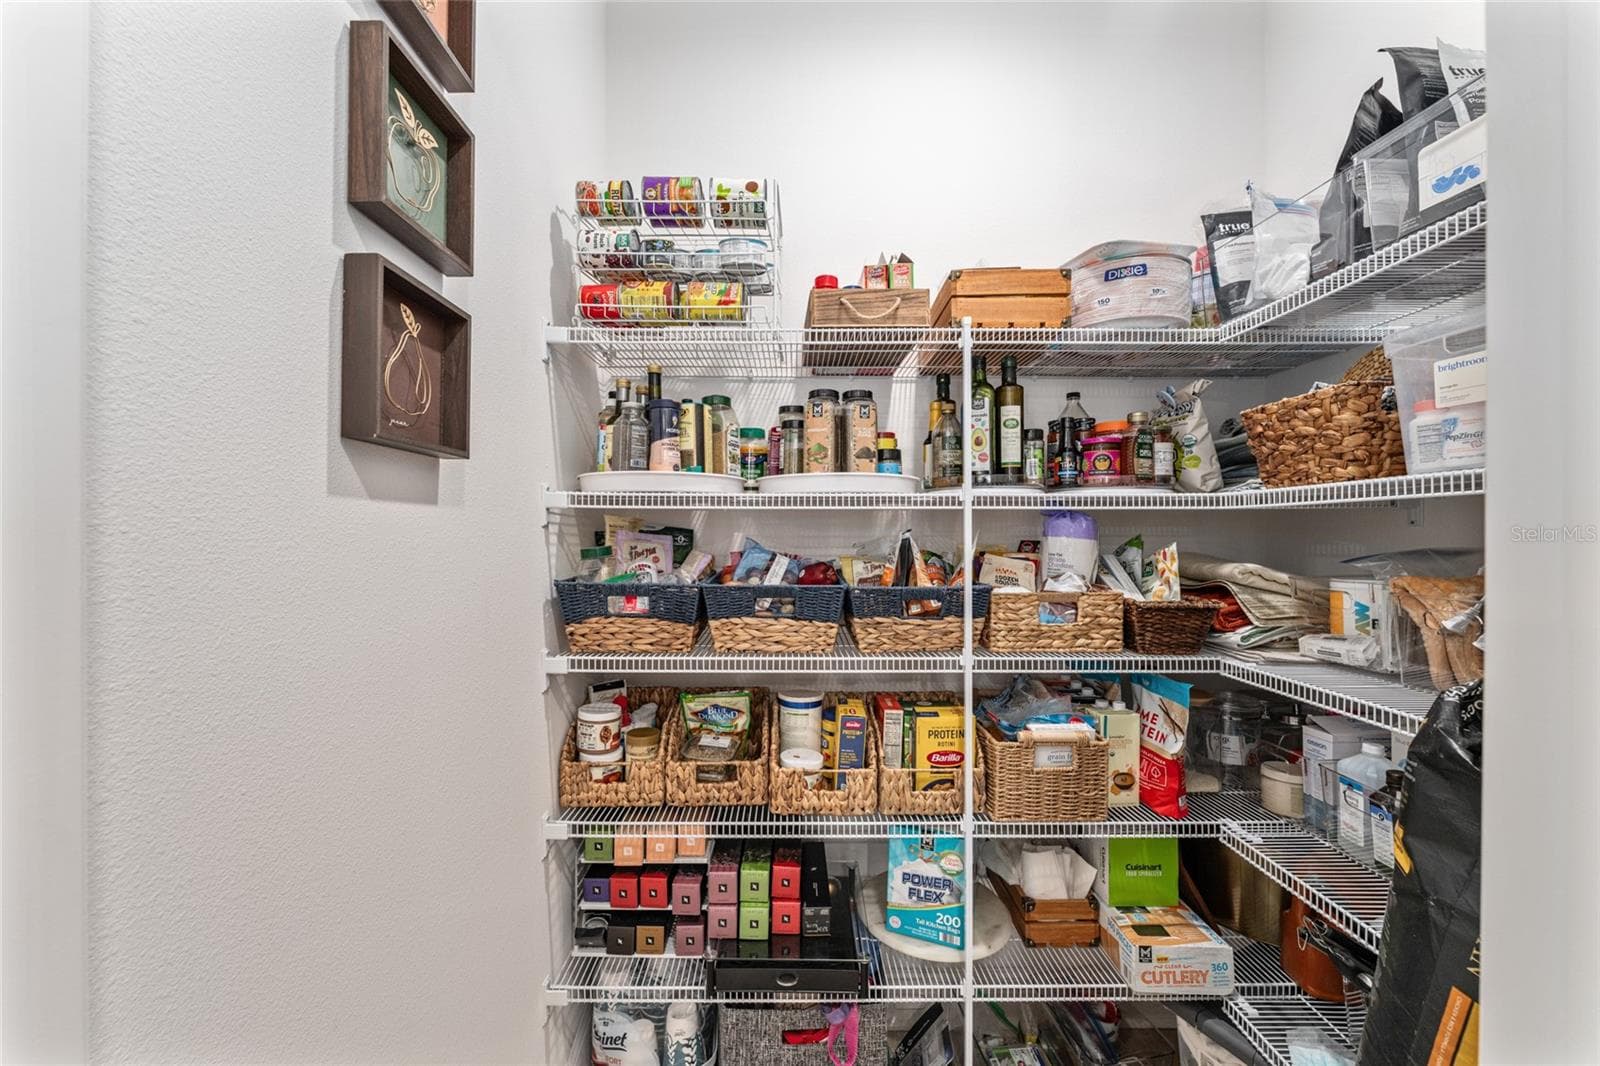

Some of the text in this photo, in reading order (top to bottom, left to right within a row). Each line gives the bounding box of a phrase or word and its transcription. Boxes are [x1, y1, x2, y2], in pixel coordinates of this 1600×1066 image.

[1218, 222, 1250, 232] true
[928, 729, 965, 740] PROTEIN
[1141, 723, 1168, 745] TEIN
[931, 753, 961, 762] Barilla
[1125, 863, 1163, 871] Cuisinart
[902, 872, 953, 892] POWER
[908, 887, 945, 905] FLEX
[936, 912, 961, 928] 200
[1211, 962, 1229, 972] 360
[1141, 969, 1210, 985] CUTLERY
